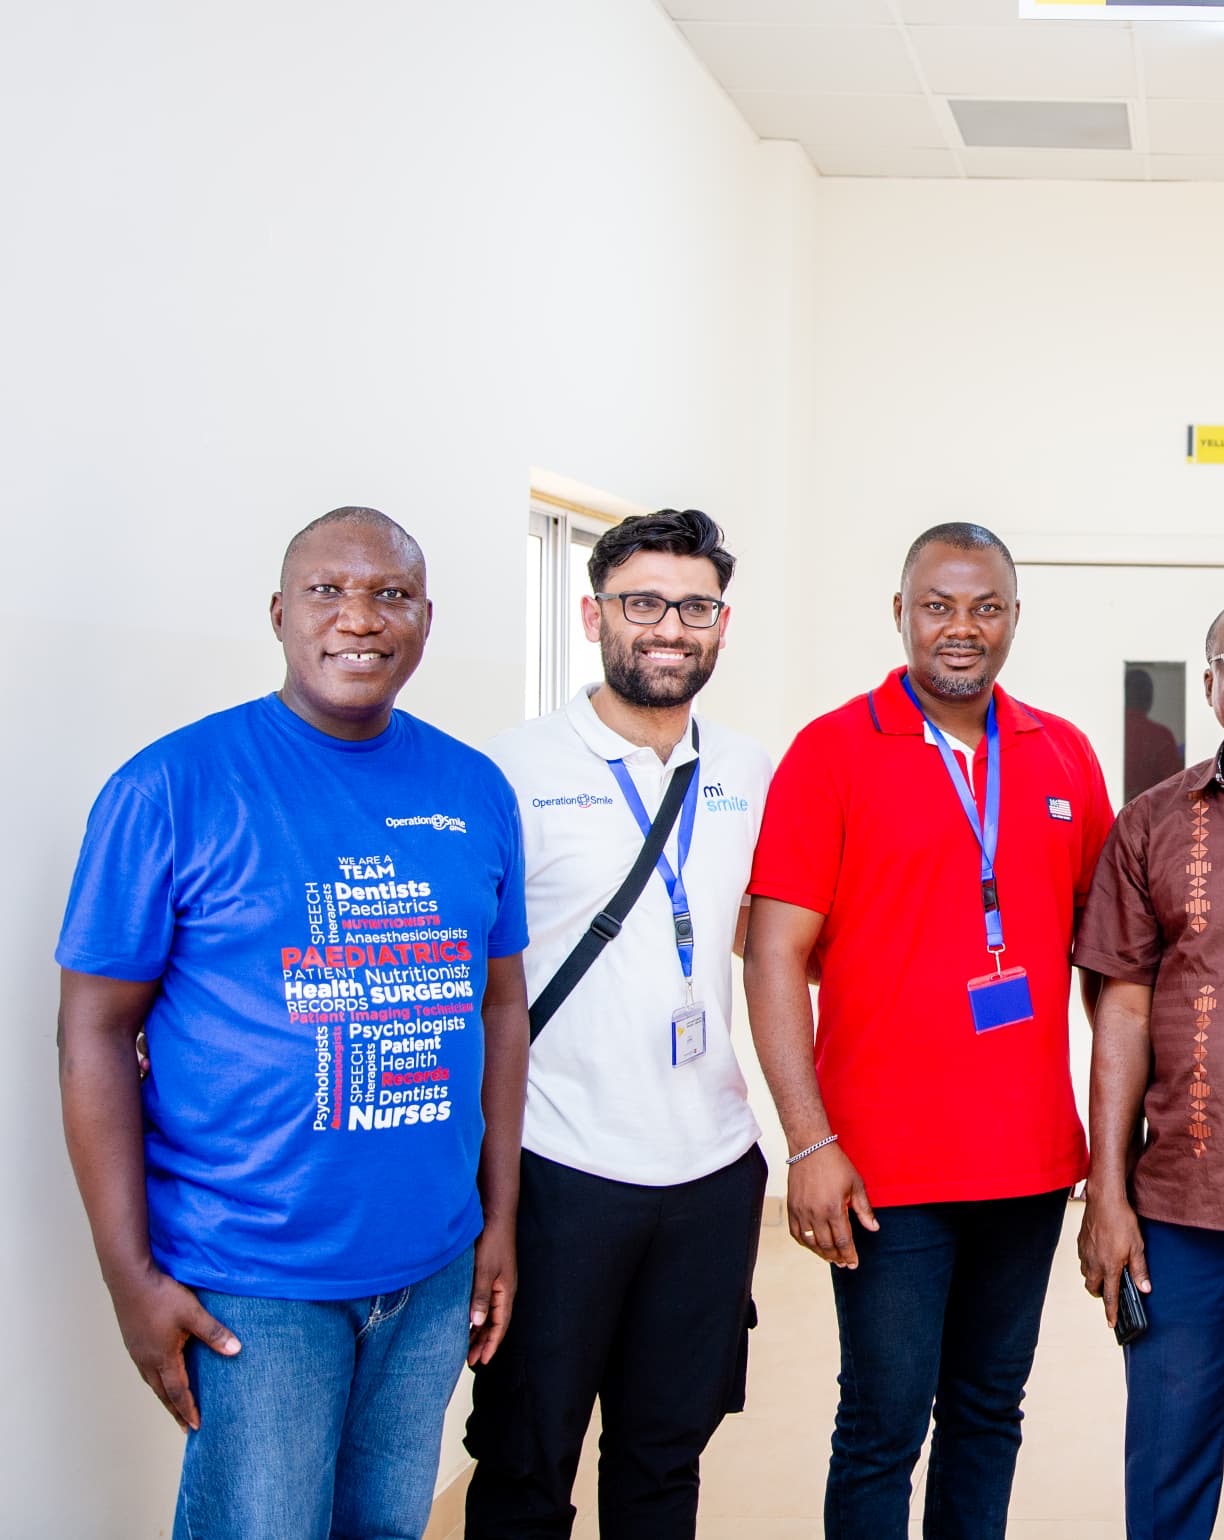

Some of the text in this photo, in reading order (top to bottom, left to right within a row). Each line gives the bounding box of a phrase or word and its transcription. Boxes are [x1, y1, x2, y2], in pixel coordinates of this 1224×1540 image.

[532, 794, 614, 808] Operation Smile
[703, 782, 724, 799] mi
[706, 799, 748, 813] smile
[385, 815, 466, 829] Operation Smile
[338, 854, 393, 865] WE ARE A
[339, 863, 396, 880] TEAM
[334, 880, 431, 901] Dentists
[304, 881, 326, 945] SPEECH
[323, 883, 340, 944] therapists
[338, 899, 438, 916] Paediatrics
[341, 915, 440, 929] NUTRITIONISTS
[345, 927, 468, 944] Anaesthesiologists
[281, 939, 472, 970] PAEDIATRICS
[283, 963, 470, 986] PATIENT Nutritionists
[284, 979, 473, 1004] Health SURGEONS
[286, 997, 369, 1013] RECORDS
[290, 1009, 345, 1024] Patient
[350, 1006, 410, 1022] Imaging
[349, 1015, 466, 1040] Psychologists
[380, 1036, 441, 1054] Patient
[381, 1051, 437, 1072] Health
[313, 1025, 331, 1131] Psychologists
[350, 1043, 364, 1103] SPEECH
[365, 1042, 377, 1103] therapists
[381, 1066, 449, 1088] Records
[379, 1084, 448, 1106] Dentists
[348, 1100, 452, 1131] Nurses
